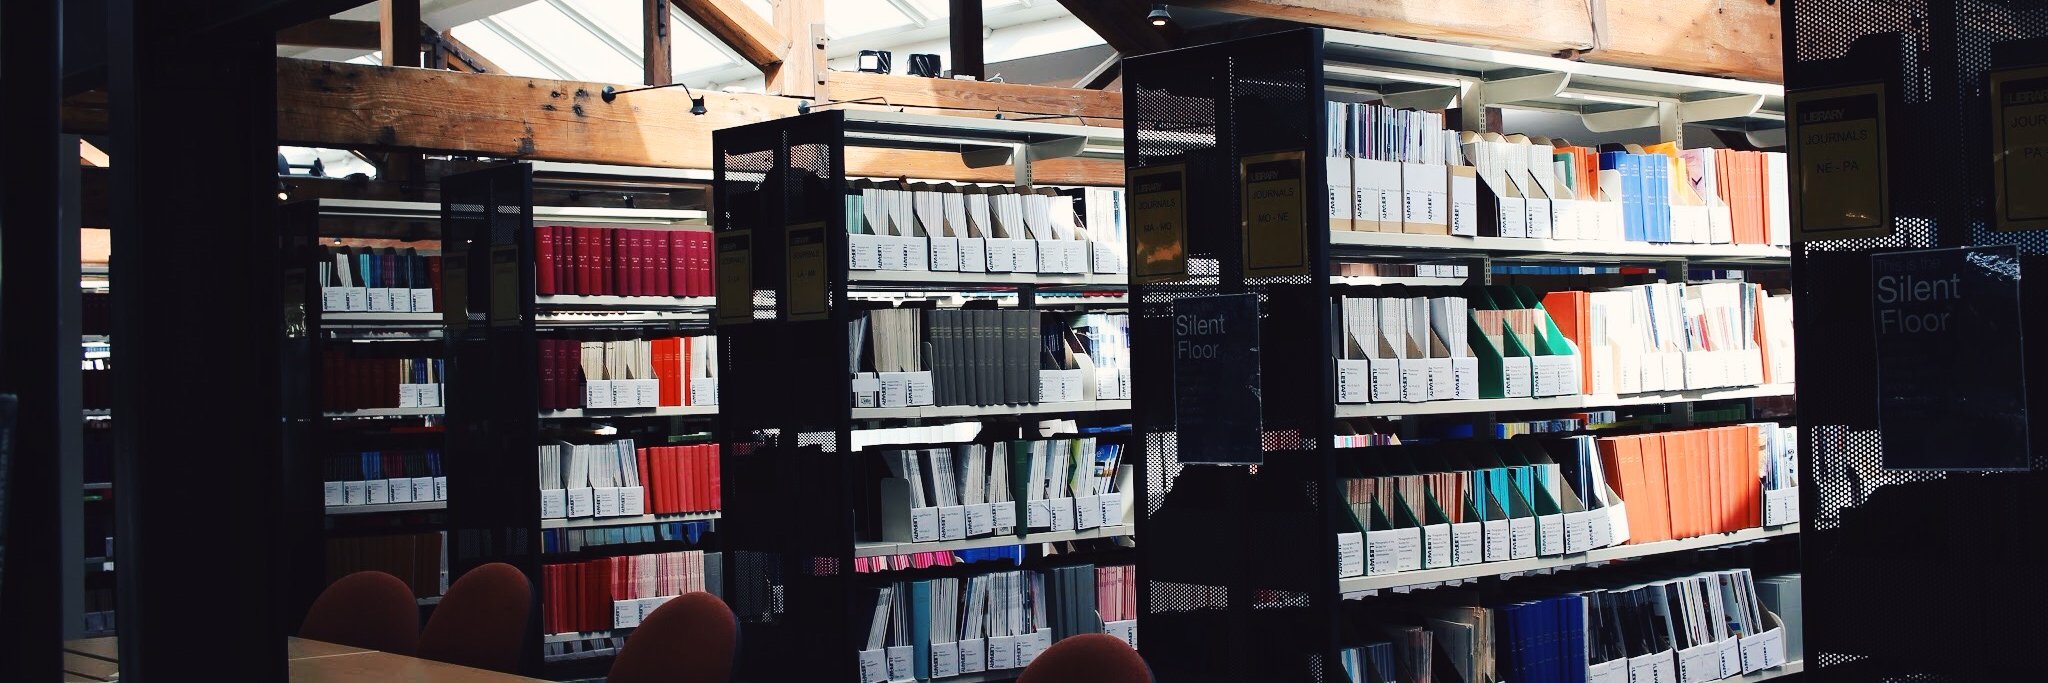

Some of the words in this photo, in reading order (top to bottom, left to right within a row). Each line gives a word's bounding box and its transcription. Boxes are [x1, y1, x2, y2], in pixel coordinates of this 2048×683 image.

[1803, 108, 1846, 123] LIBRARY
[1806, 129, 1869, 145] JOURNALS
[1817, 162, 1833, 174] NE
[1843, 160, 1859, 173] PA
[1253, 188, 1295, 199] JOURNALS
[1877, 273, 1961, 304] Silent
[1176, 313, 1226, 336] Silent
[1880, 308, 1952, 335] Floor
[1178, 339, 1220, 360] Floor
